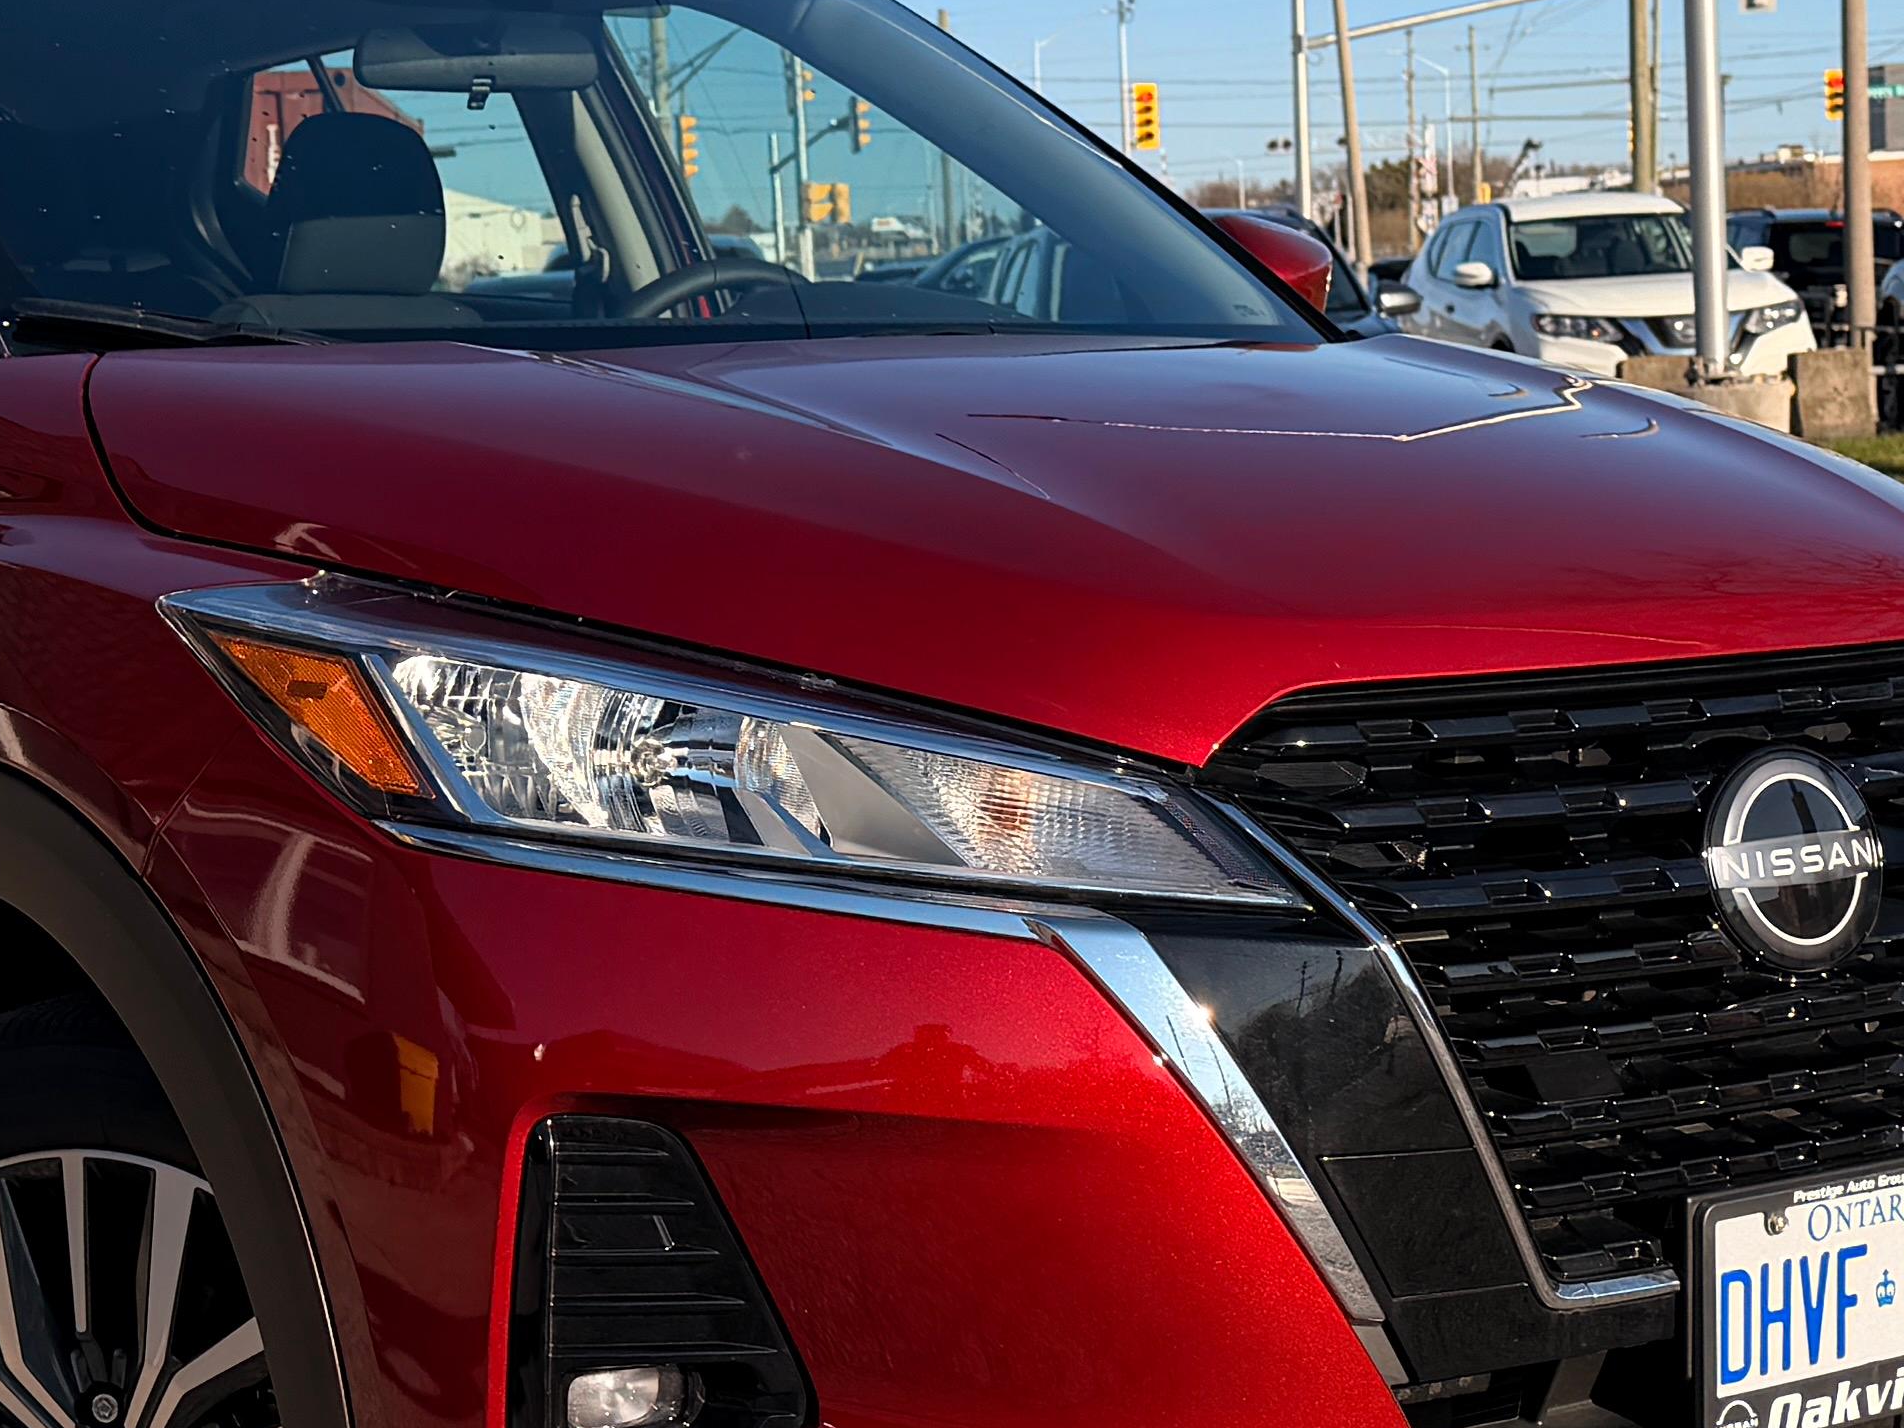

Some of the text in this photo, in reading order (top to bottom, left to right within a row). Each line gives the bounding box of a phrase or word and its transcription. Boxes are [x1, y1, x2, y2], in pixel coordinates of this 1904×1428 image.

[1718, 836, 1874, 881] NISSAN
[1793, 1184, 1845, 1204] Prestige
[1846, 1177, 1876, 1194] Auto
[1720, 1243, 1868, 1386] DHVF
